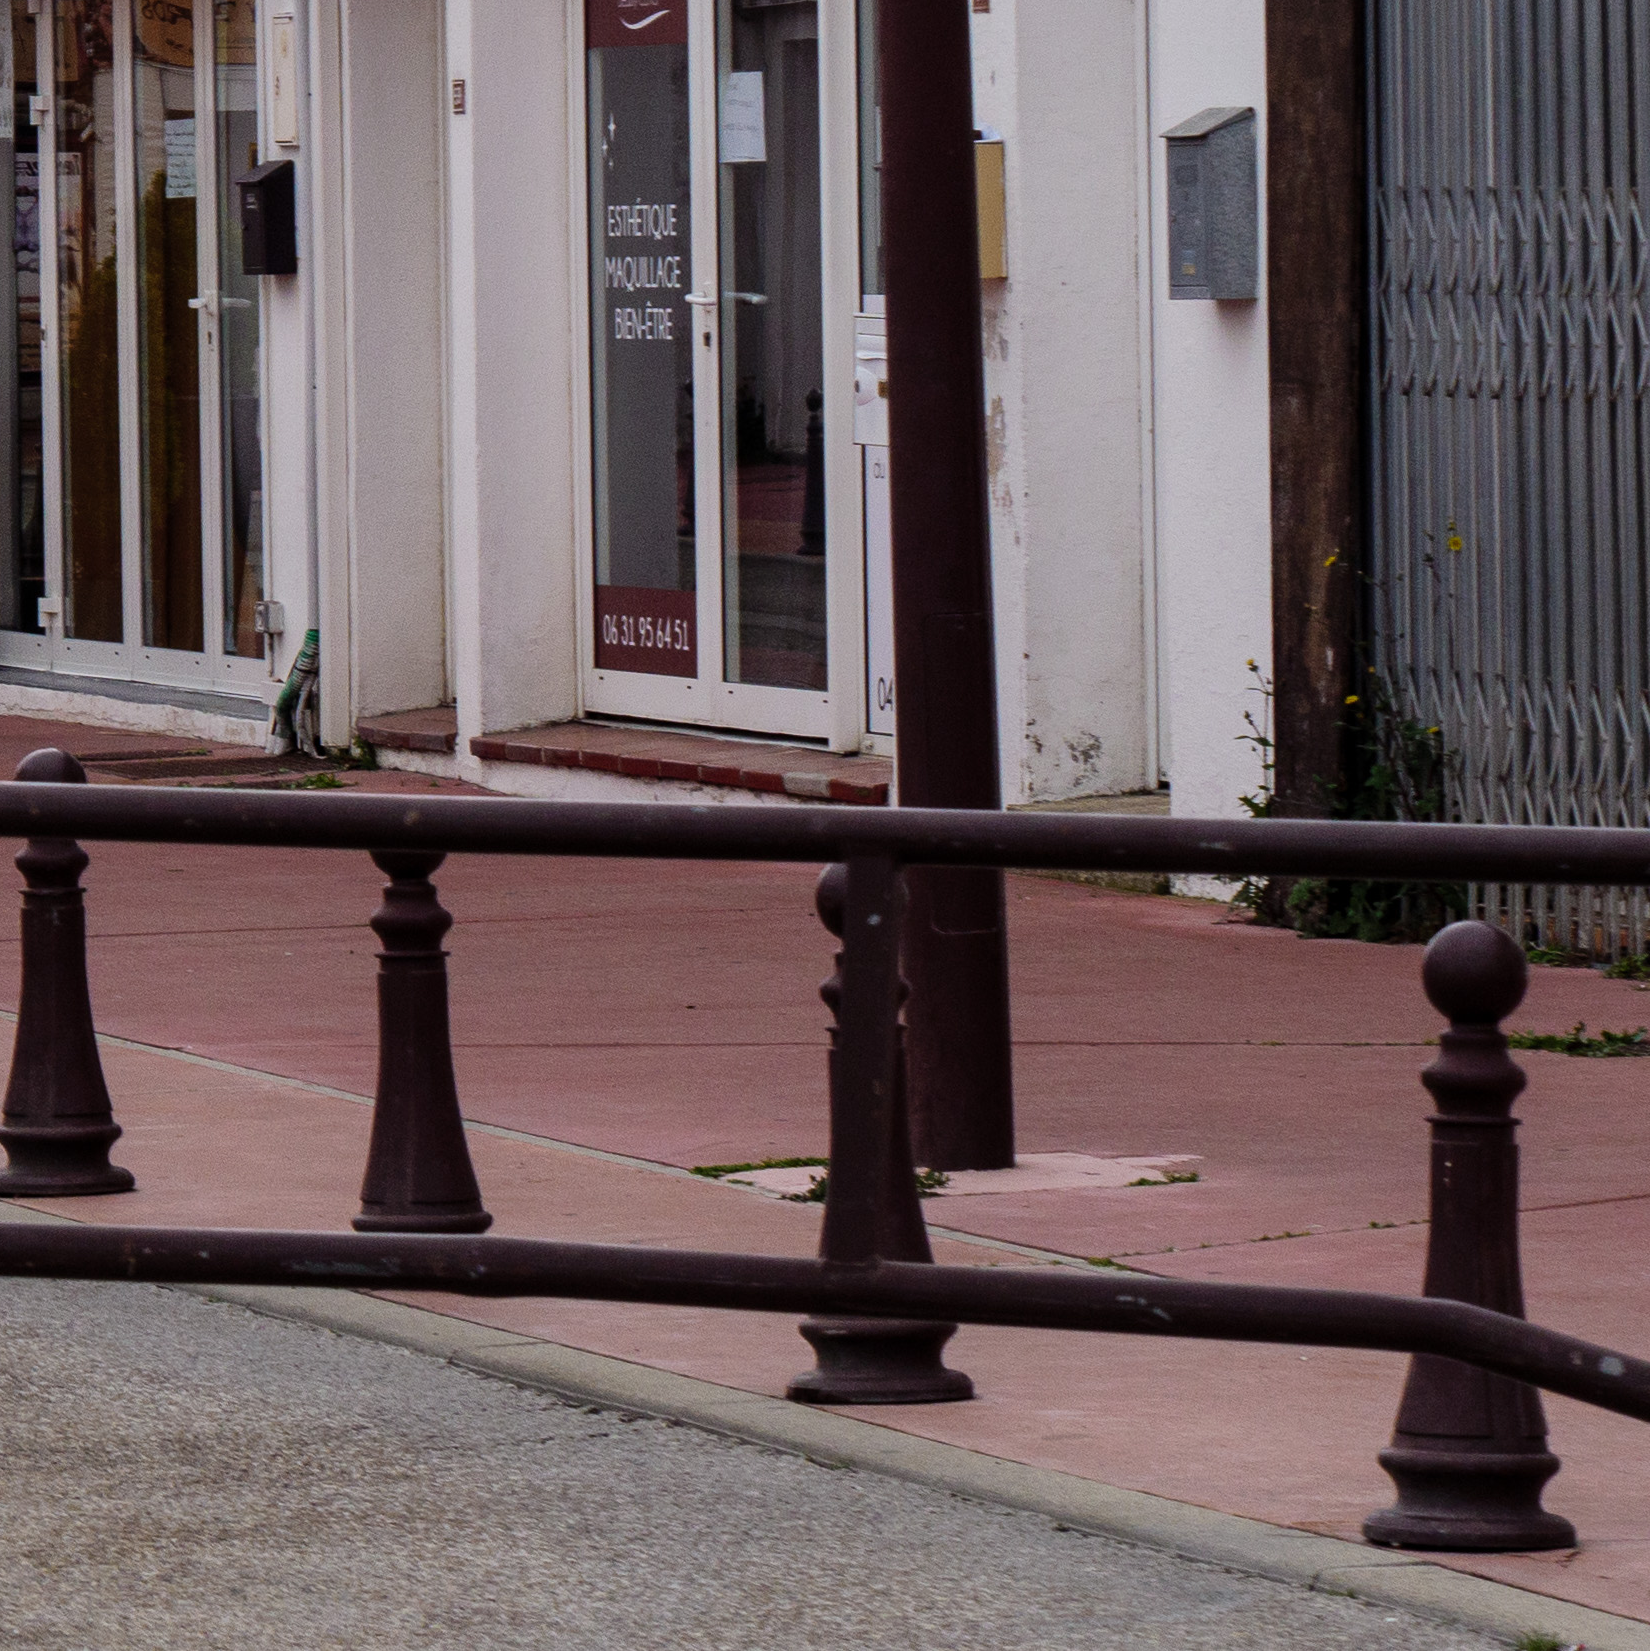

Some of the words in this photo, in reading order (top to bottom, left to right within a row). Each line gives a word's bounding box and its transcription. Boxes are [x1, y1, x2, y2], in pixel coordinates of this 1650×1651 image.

[607, 197, 677, 240] ESTHÉTIQUE
[605, 255, 681, 291] MAQUILLAGE
[615, 300, 673, 340] BIEN-ÊTRE
[603, 614, 618, 645] 06
[621, 614, 636, 646] 31
[639, 616, 654, 648] 95
[656, 617, 672, 649] 64
[674, 619, 690, 651] 51
